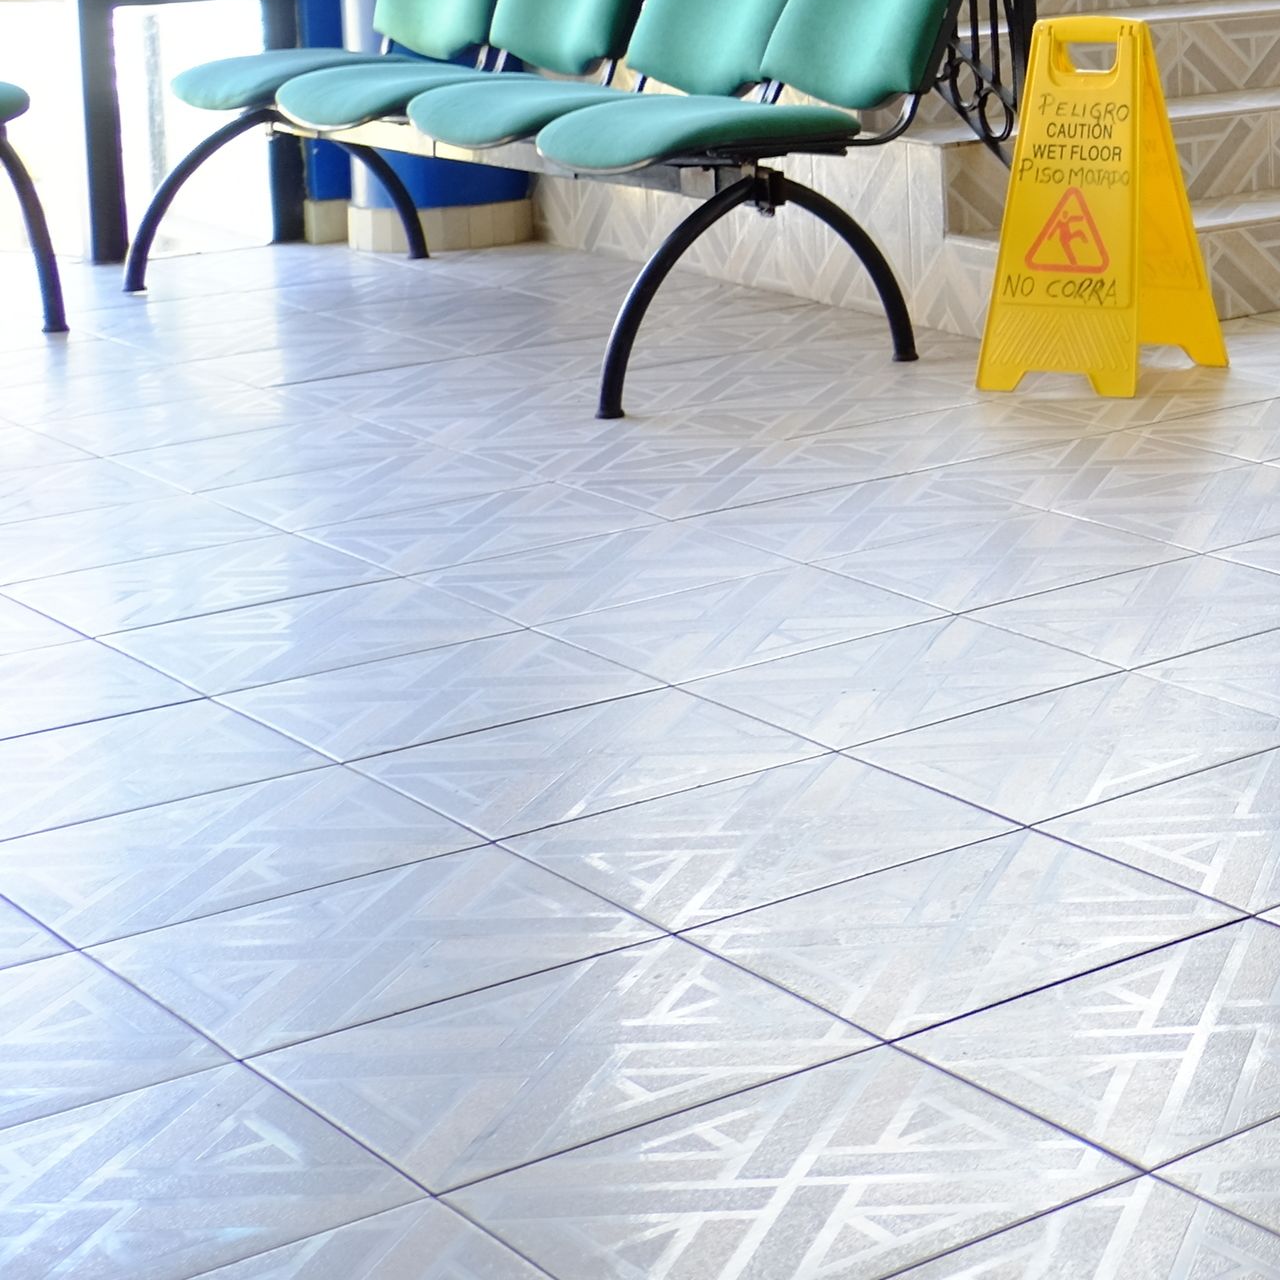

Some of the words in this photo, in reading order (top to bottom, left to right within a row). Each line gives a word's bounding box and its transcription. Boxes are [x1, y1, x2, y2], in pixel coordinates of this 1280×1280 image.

[1038, 92, 1129, 125] PELIGRO
[1046, 122, 1113, 139] CAUTION
[1032, 144, 1067, 160] WET
[1070, 145, 1122, 161] FLOOR
[1018, 158, 1065, 184] PISO
[1003, 273, 1035, 298] NO
[1046, 278, 1117, 306] CORRA
